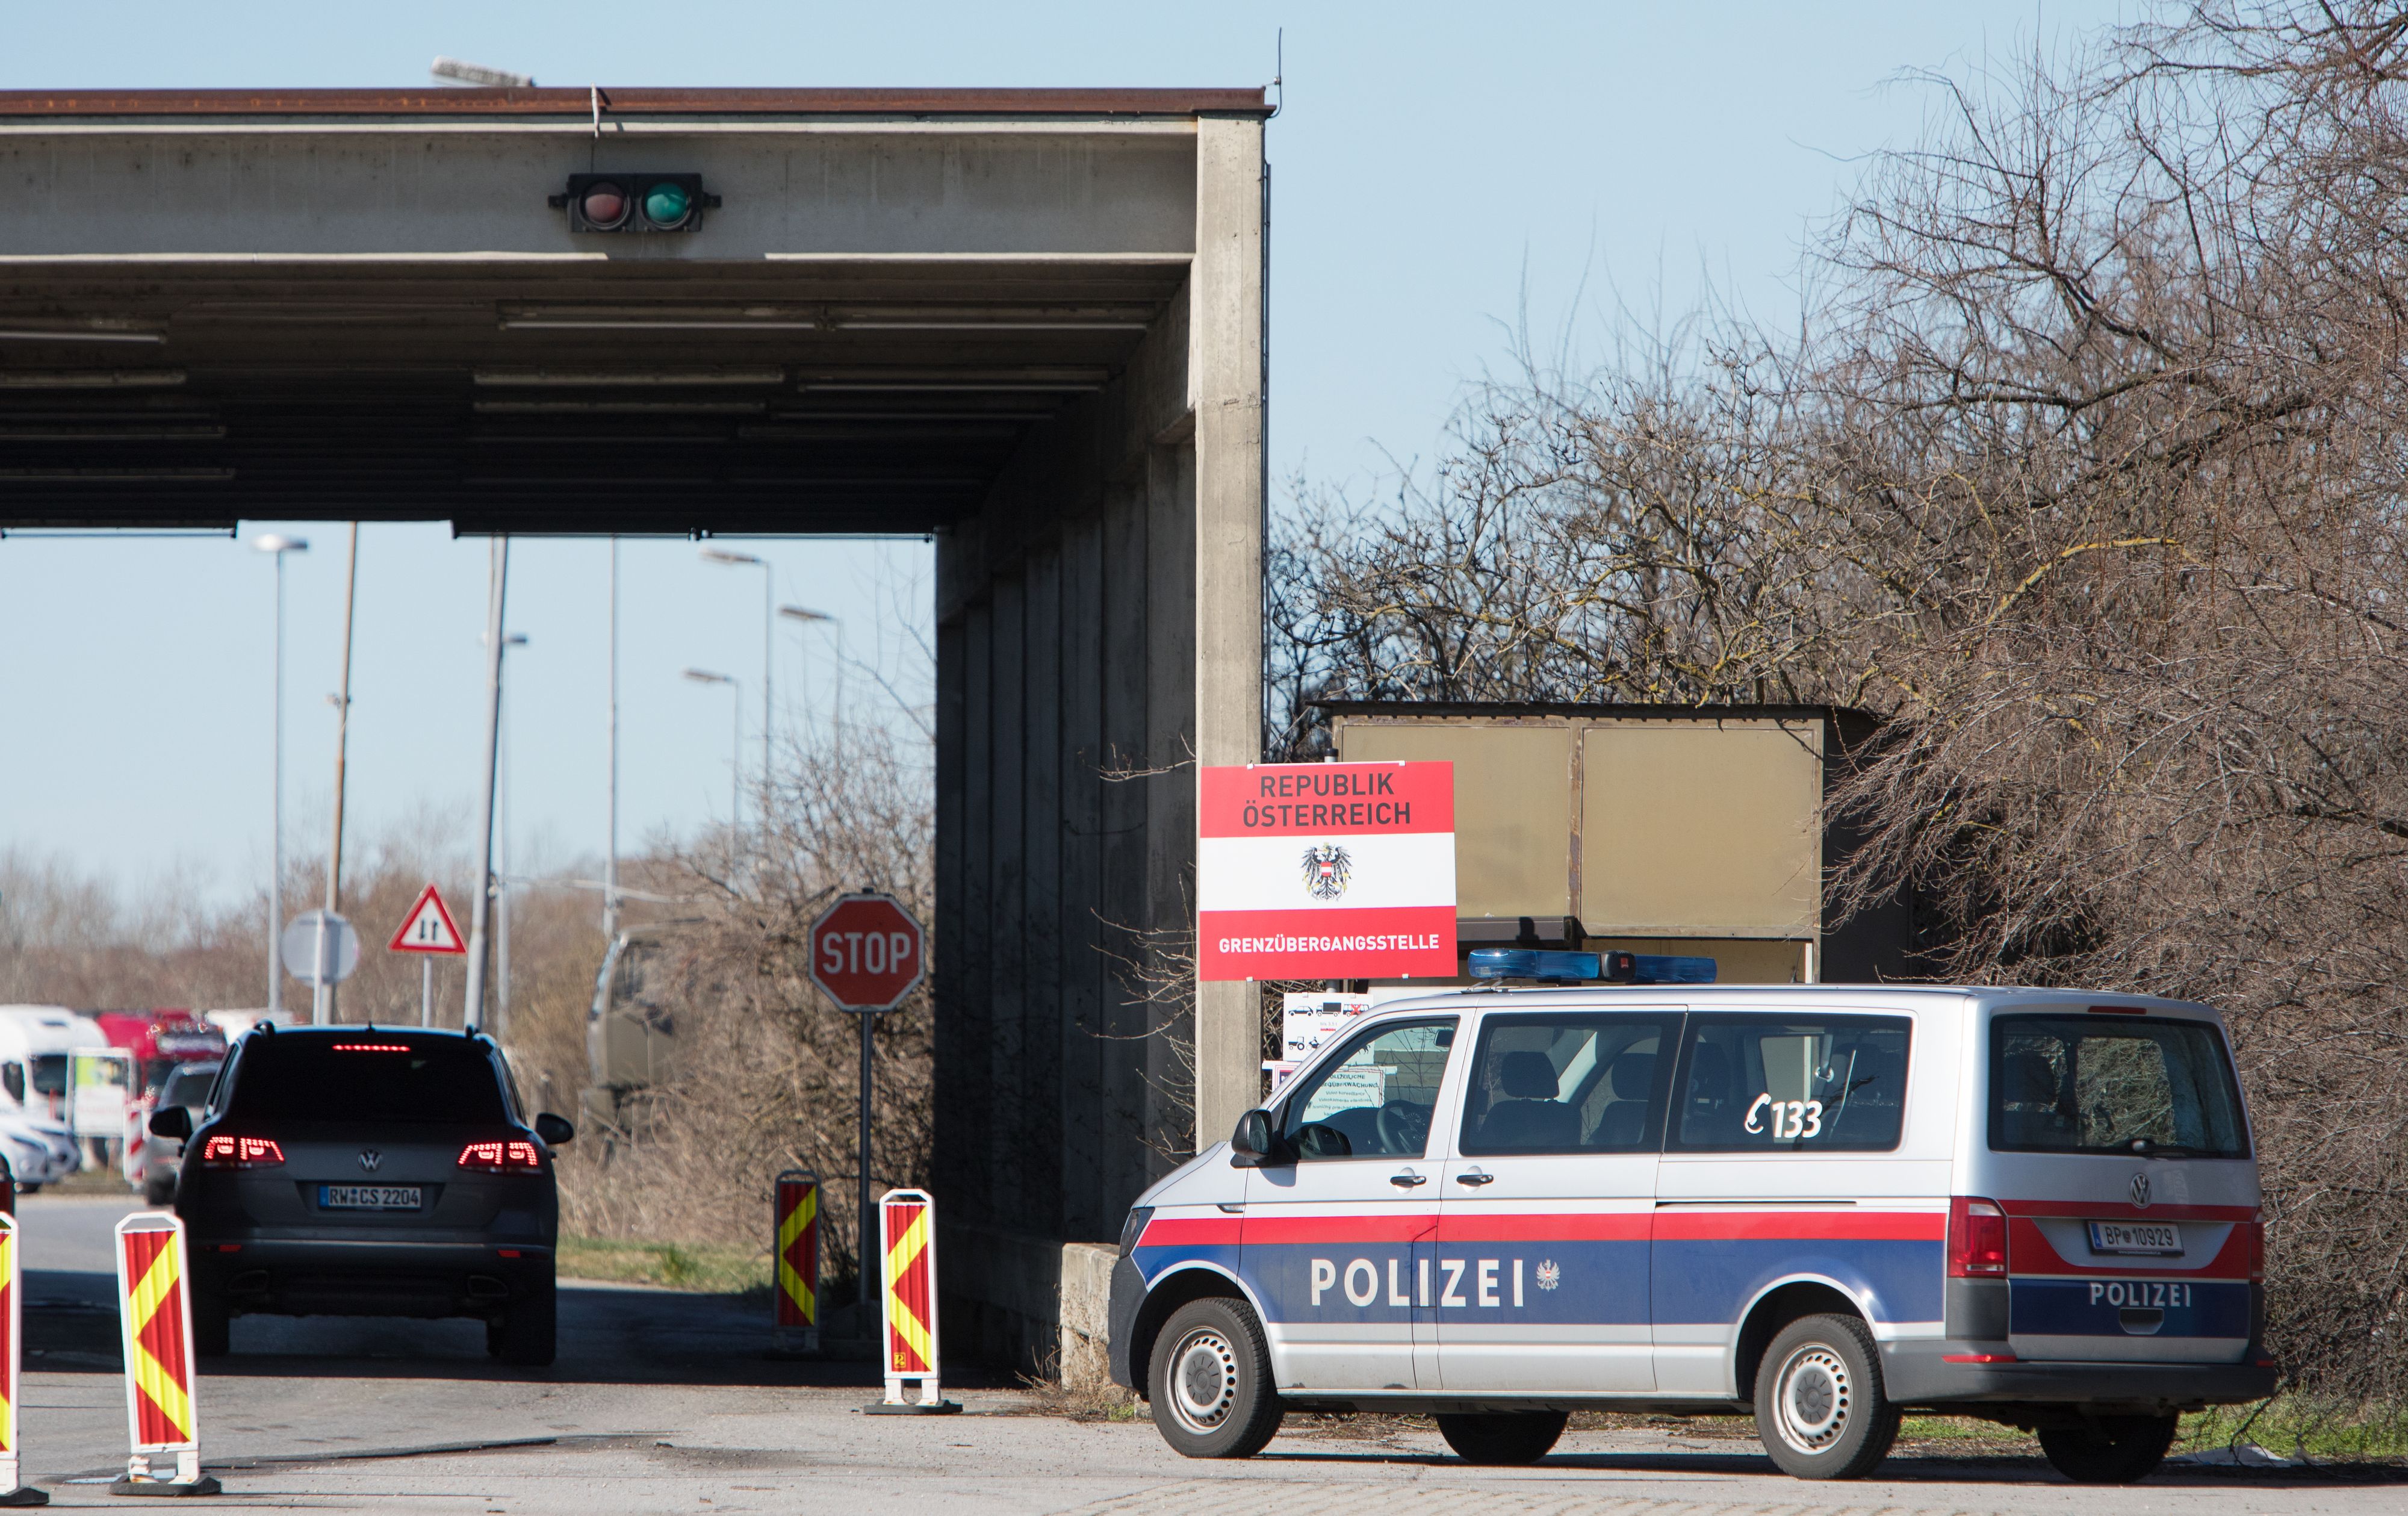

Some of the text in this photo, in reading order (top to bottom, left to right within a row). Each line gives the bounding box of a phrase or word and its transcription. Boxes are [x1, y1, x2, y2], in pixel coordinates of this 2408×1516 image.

[1261, 772, 1394, 798] REPUBLIK
[1243, 800, 1410, 827] ÖSTERREICH
[822, 931, 911, 974] STOP
[1219, 934, 1439, 953] GRENZÜBERGANGSSTELLE
[1772, 1101, 1822, 1138] 133
[330, 1188, 419, 1205] RW CS 2204
[2105, 1226, 2121, 1245] BP
[2132, 1227, 2174, 1246] 10929
[1311, 1258, 1524, 1307] POLIZEI
[2090, 1282, 2191, 1307] POLIZEI
